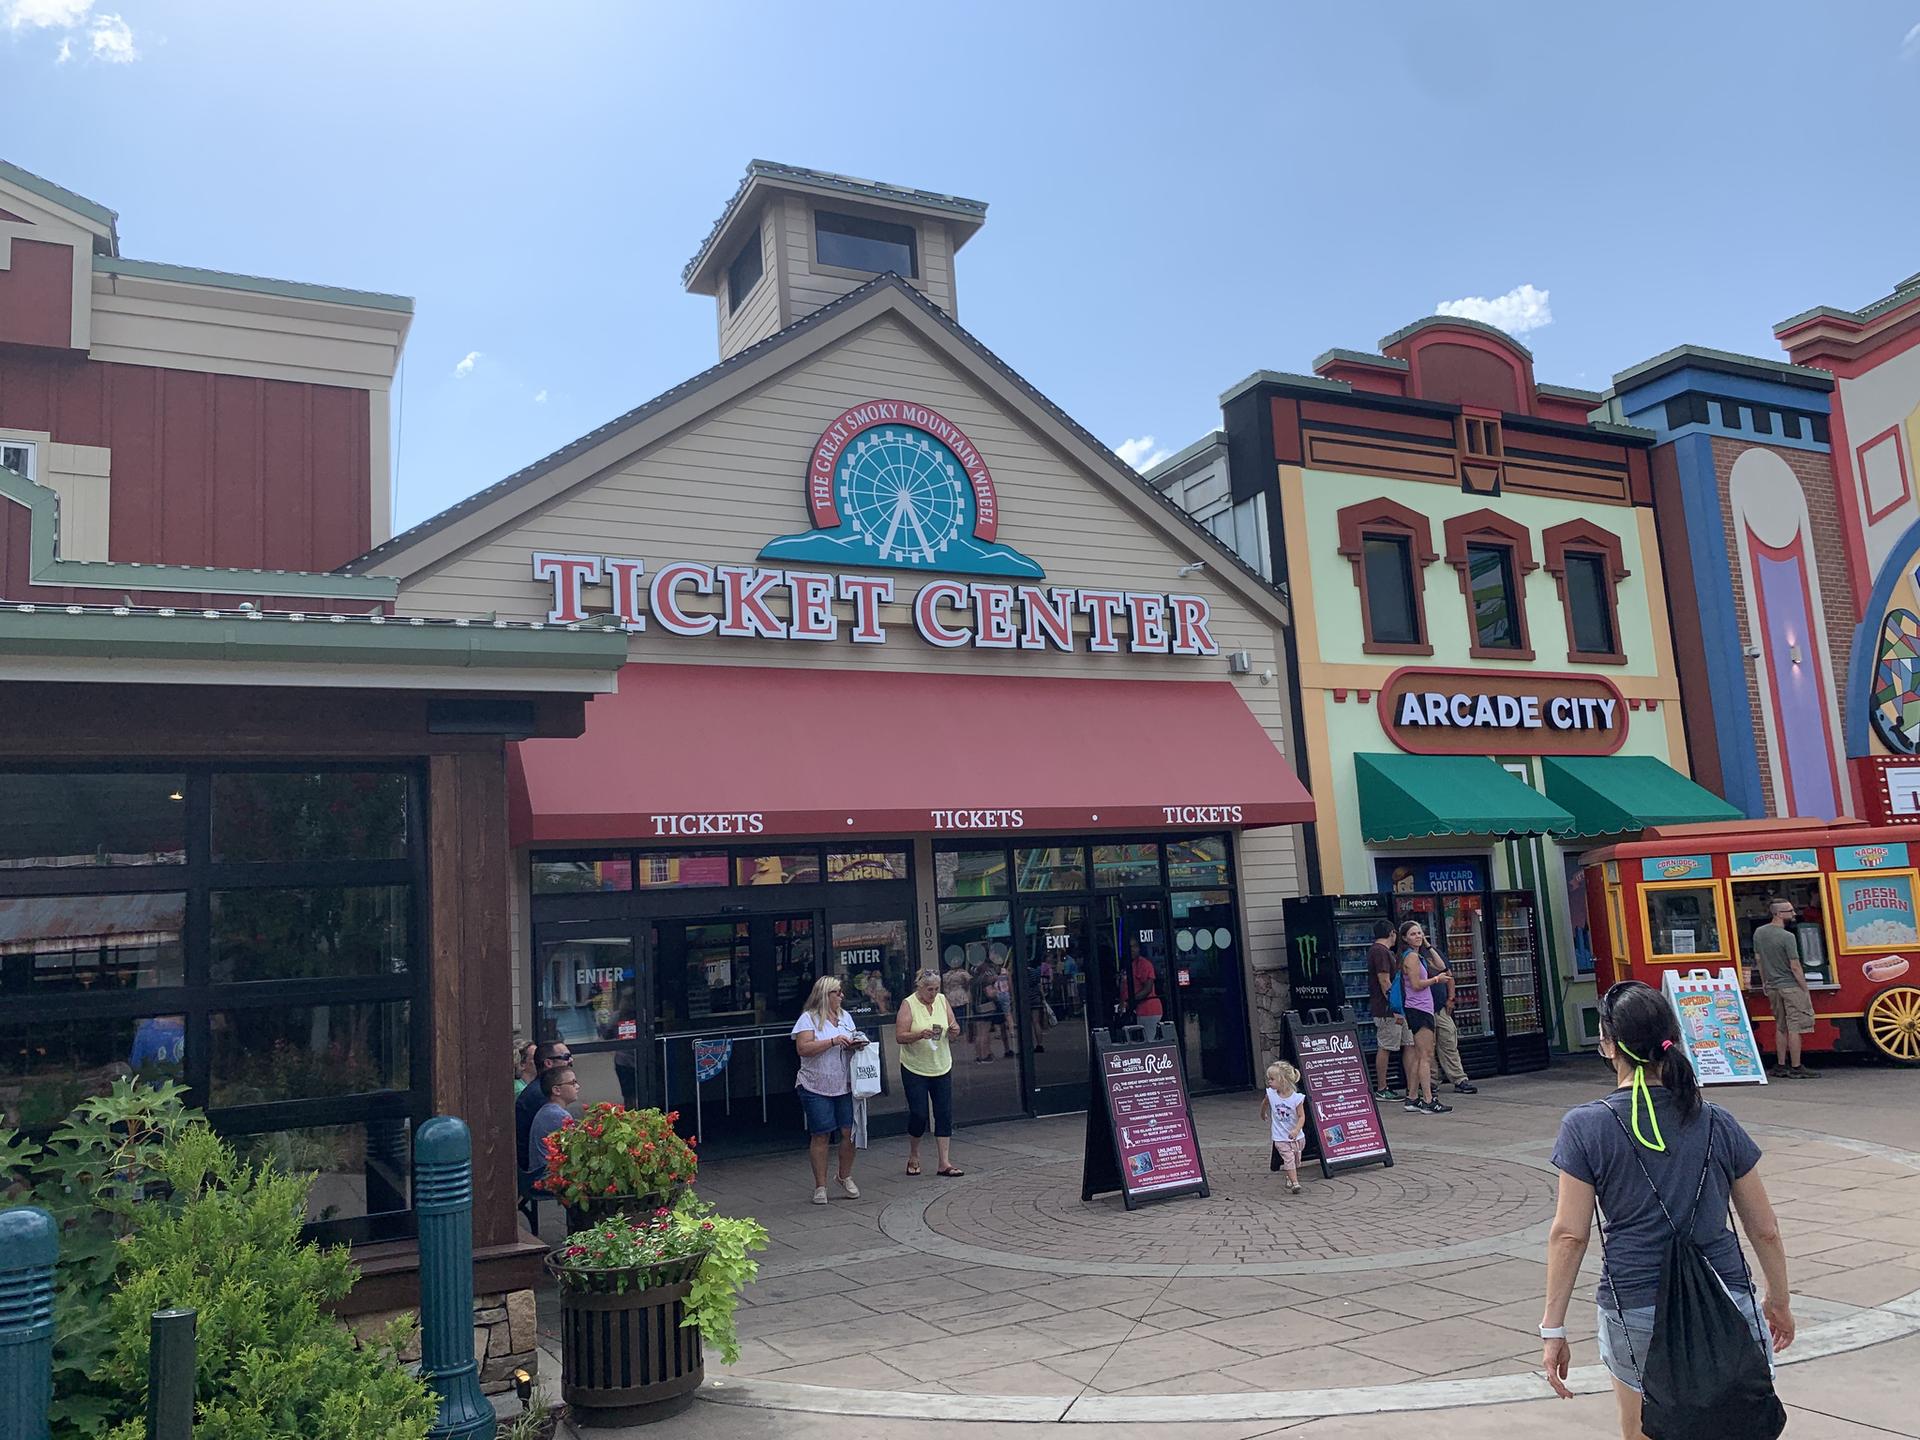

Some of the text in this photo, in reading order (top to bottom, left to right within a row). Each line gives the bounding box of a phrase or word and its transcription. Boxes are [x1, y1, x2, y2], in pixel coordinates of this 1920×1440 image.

[814, 403, 993, 525] THE GREAT SMOKY MOUNTAIN WHEEL
[533, 551, 1219, 656] TICKET CENTER
[1398, 692, 1617, 729] ARCADE CITY
[931, 809, 1024, 829] TICKETS
[1163, 805, 1244, 824] TICKETS
[651, 813, 764, 835] TICKETS
[1754, 854, 1792, 864] POPCORN
[1855, 847, 1888, 857] NACHOS
[1657, 859, 1698, 870] CORN DOGS
[1429, 870, 1473, 881] PLAY CARD
[1430, 879, 1474, 893] SPECIALS
[1854, 887, 1898, 901] FRESH
[1349, 899, 1378, 907] MONSTER
[1847, 898, 1908, 914] POPCORN
[924, 902, 934, 951] 1102
[1046, 935, 1070, 949] EXIT
[1140, 929, 1154, 943] EXIT
[840, 949, 881, 965] ENTER
[576, 967, 624, 985] ENTER
[1295, 986, 1329, 995] MONSTER
[1679, 996, 1712, 1006] POPCORN
[1329, 1035, 1354, 1053] Ride
[856, 1065, 877, 1076] Thank
[1110, 1058, 1142, 1069] THE ISLAND
[1145, 1053, 1173, 1074] Ride
